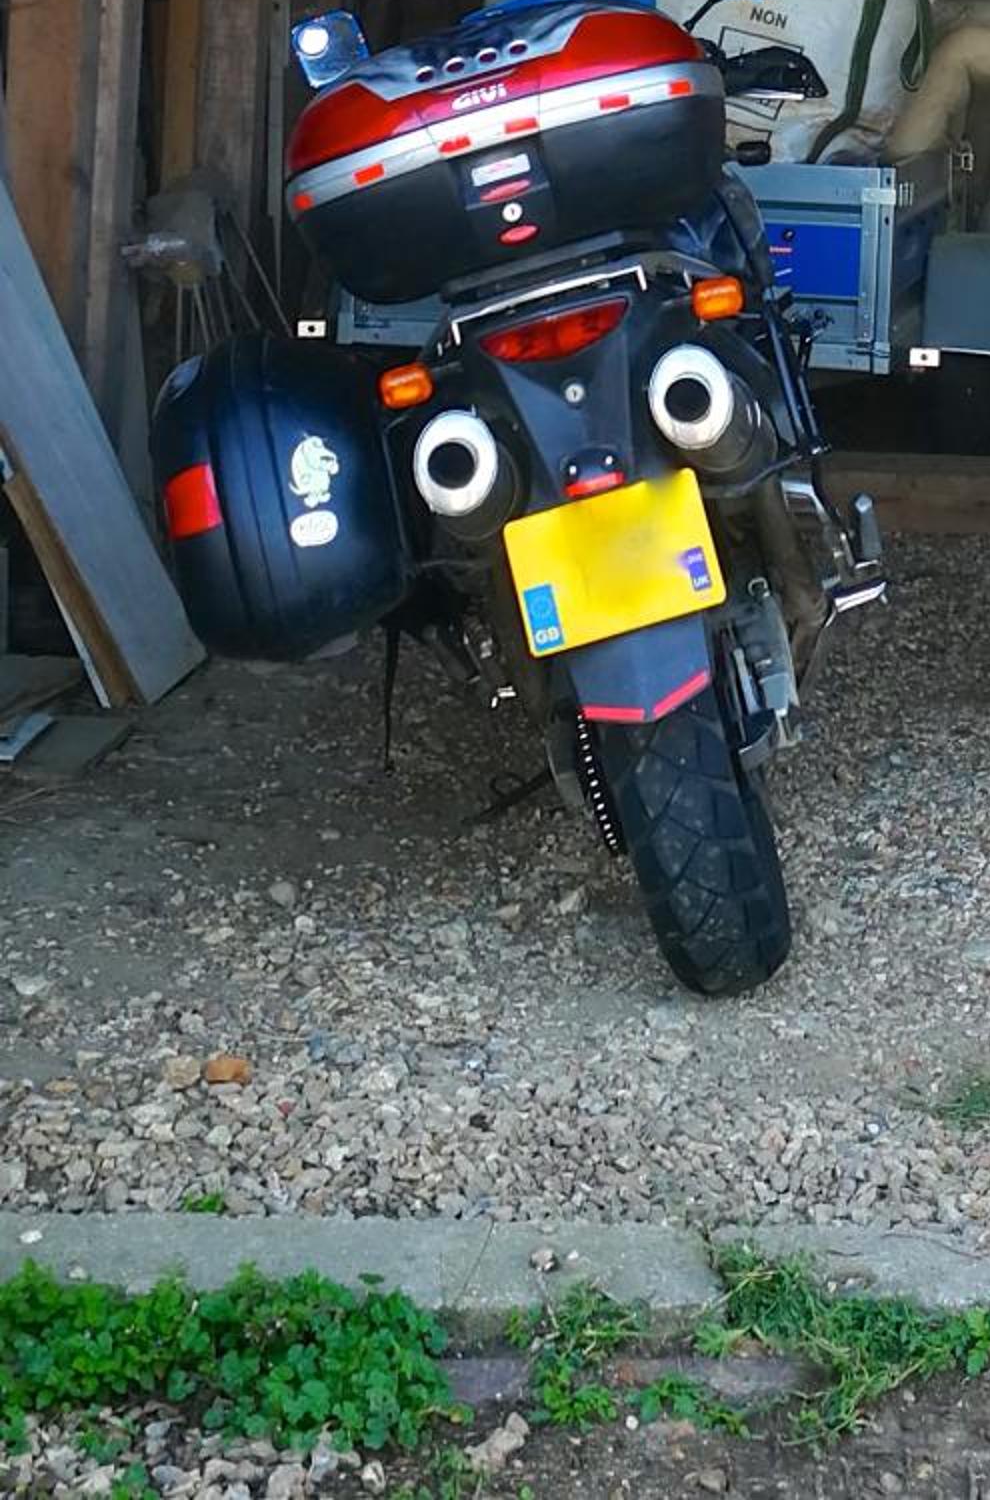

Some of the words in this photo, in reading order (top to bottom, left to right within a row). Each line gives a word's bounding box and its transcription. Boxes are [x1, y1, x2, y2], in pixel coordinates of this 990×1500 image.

[750, 6, 788, 29] NON
[451, 83, 508, 111] GIVI
[535, 625, 560, 645] GB
